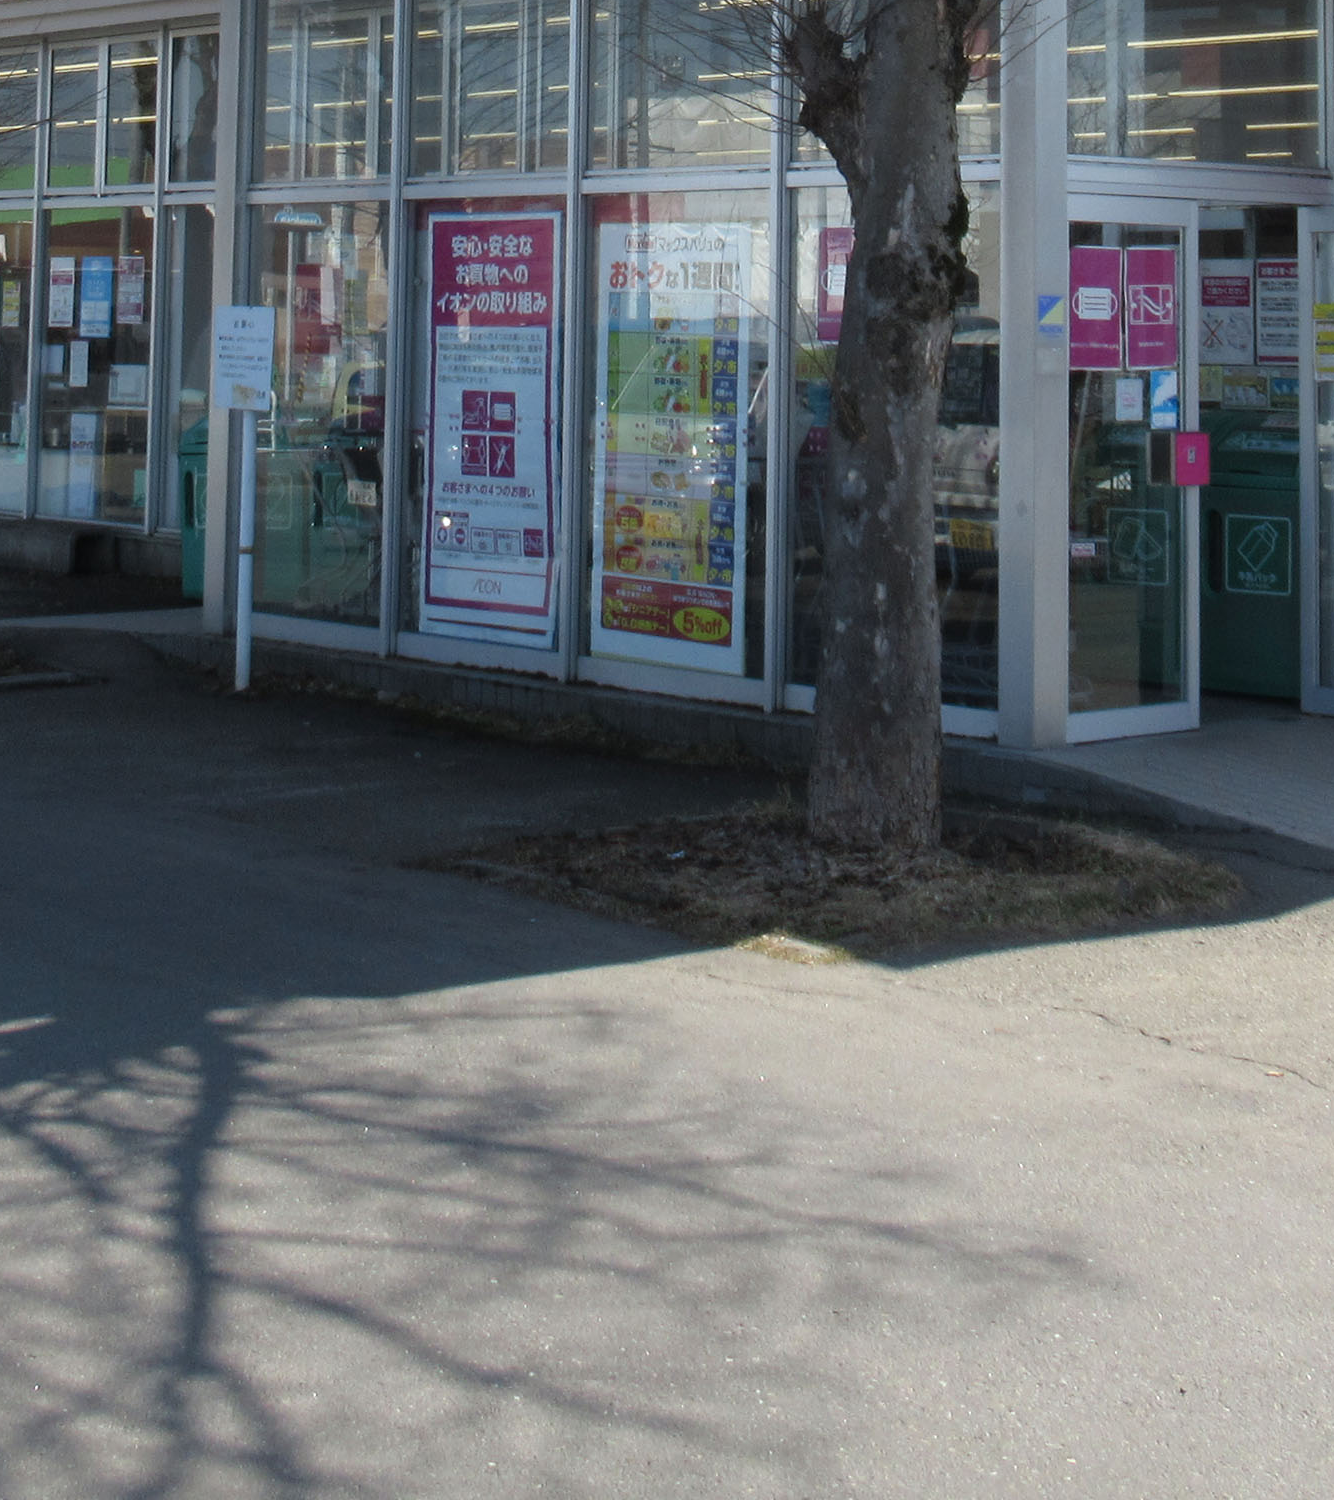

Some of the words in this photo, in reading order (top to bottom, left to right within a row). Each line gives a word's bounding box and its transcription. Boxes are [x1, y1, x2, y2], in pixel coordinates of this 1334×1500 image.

[456, 263, 529, 286] お買物への
[436, 291, 548, 315] イオンの取り組み
